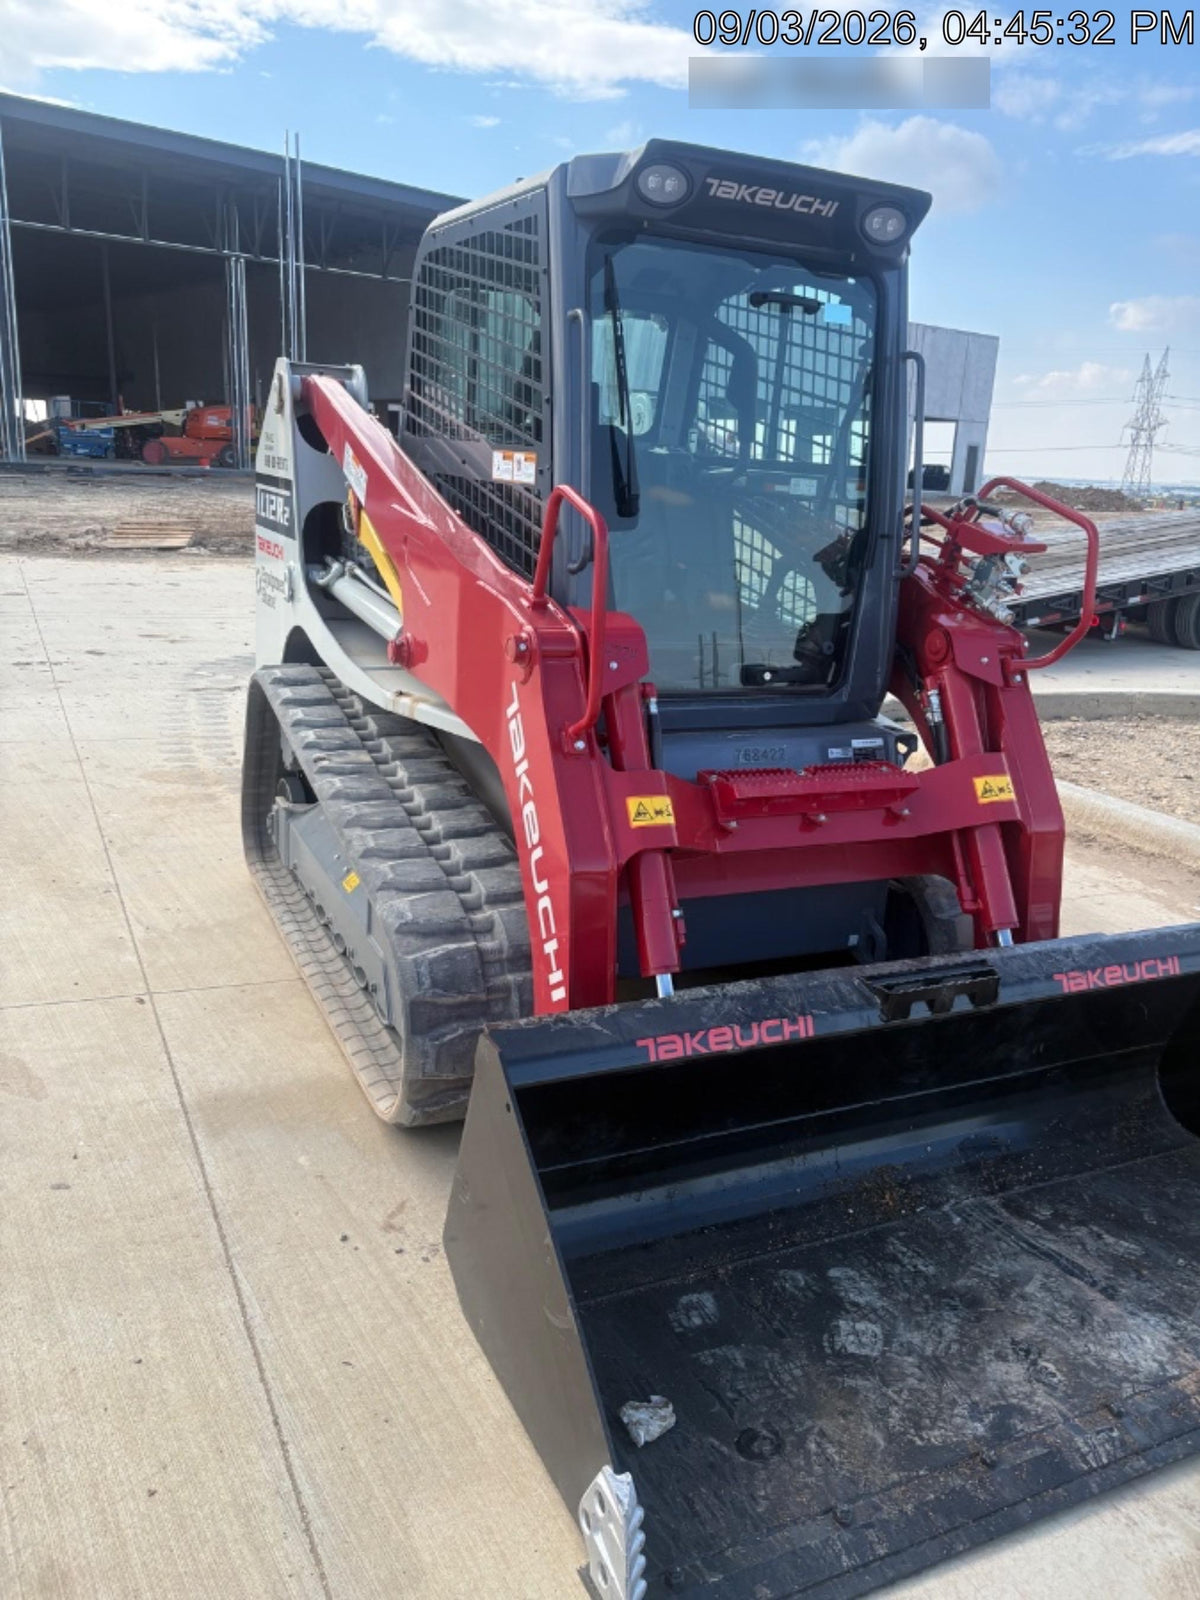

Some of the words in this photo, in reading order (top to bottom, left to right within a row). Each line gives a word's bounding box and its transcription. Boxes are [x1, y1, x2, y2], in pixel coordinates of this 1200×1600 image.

[705, 176, 840, 219] TAKEUCHI
[505, 680, 567, 1003] TAKEUCHI
[1052, 955, 1181, 994] TAKEUCHI
[636, 1015, 815, 1062] TAKEUCHI
